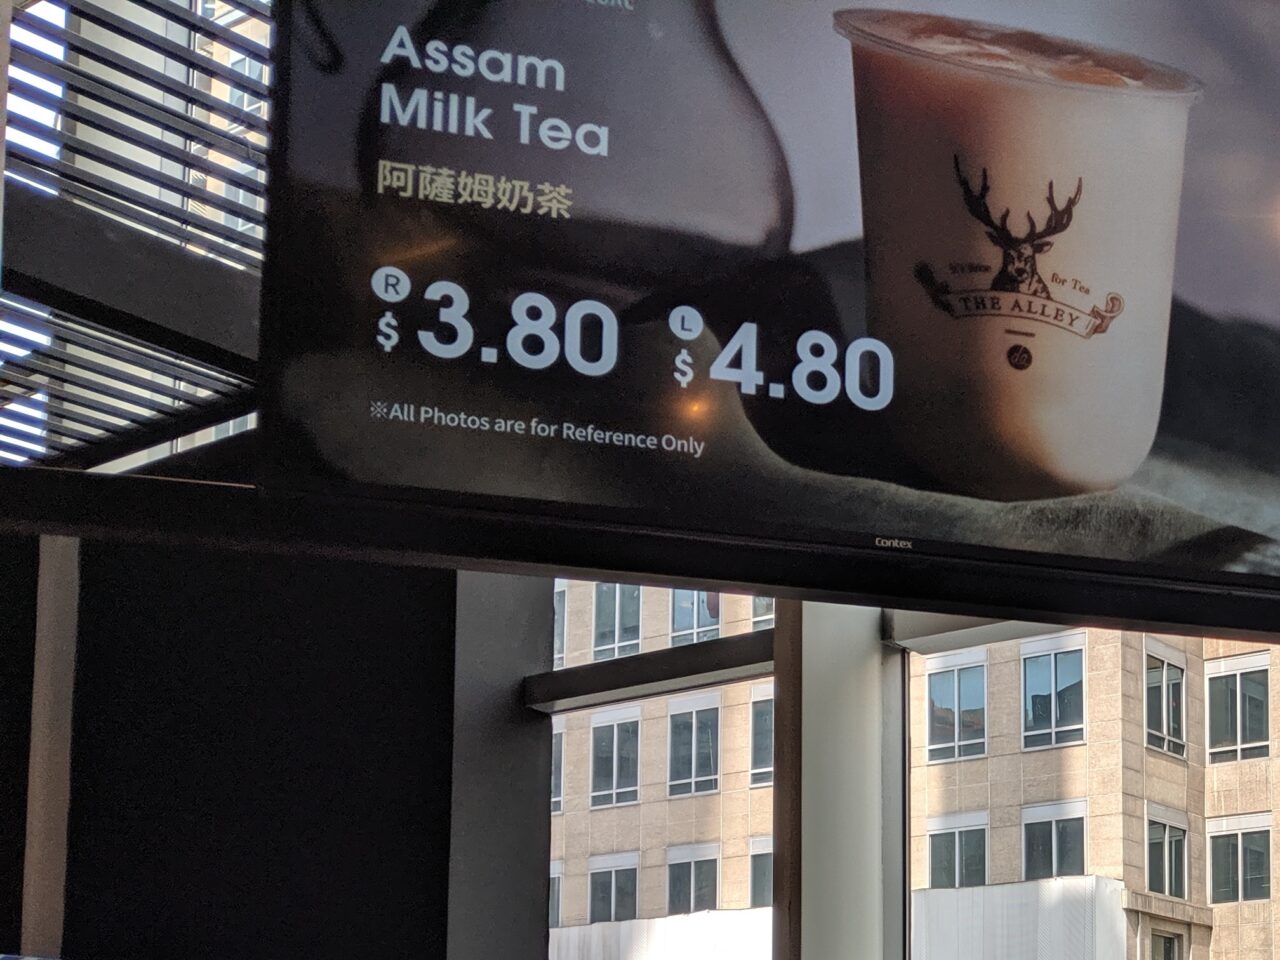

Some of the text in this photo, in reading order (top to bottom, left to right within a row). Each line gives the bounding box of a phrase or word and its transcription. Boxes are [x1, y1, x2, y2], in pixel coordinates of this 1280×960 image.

[381, 25, 566, 90] Assam
[380, 83, 609, 157] Milk Tea
[377, 160, 574, 220] 阿薩姆奶茶
[959, 297, 1080, 328] THE ALLEY
[1051, 273, 1090, 295] for Tea
[376, 281, 619, 377] $ 3.80
[674, 322, 894, 411] $ 4.80
[420, 406, 489, 430] Photos
[494, 413, 524, 434] are
[529, 417, 558, 437] for
[562, 422, 657, 447] Reference
[661, 433, 705, 458] Only
[875, 538, 912, 549] Contex
